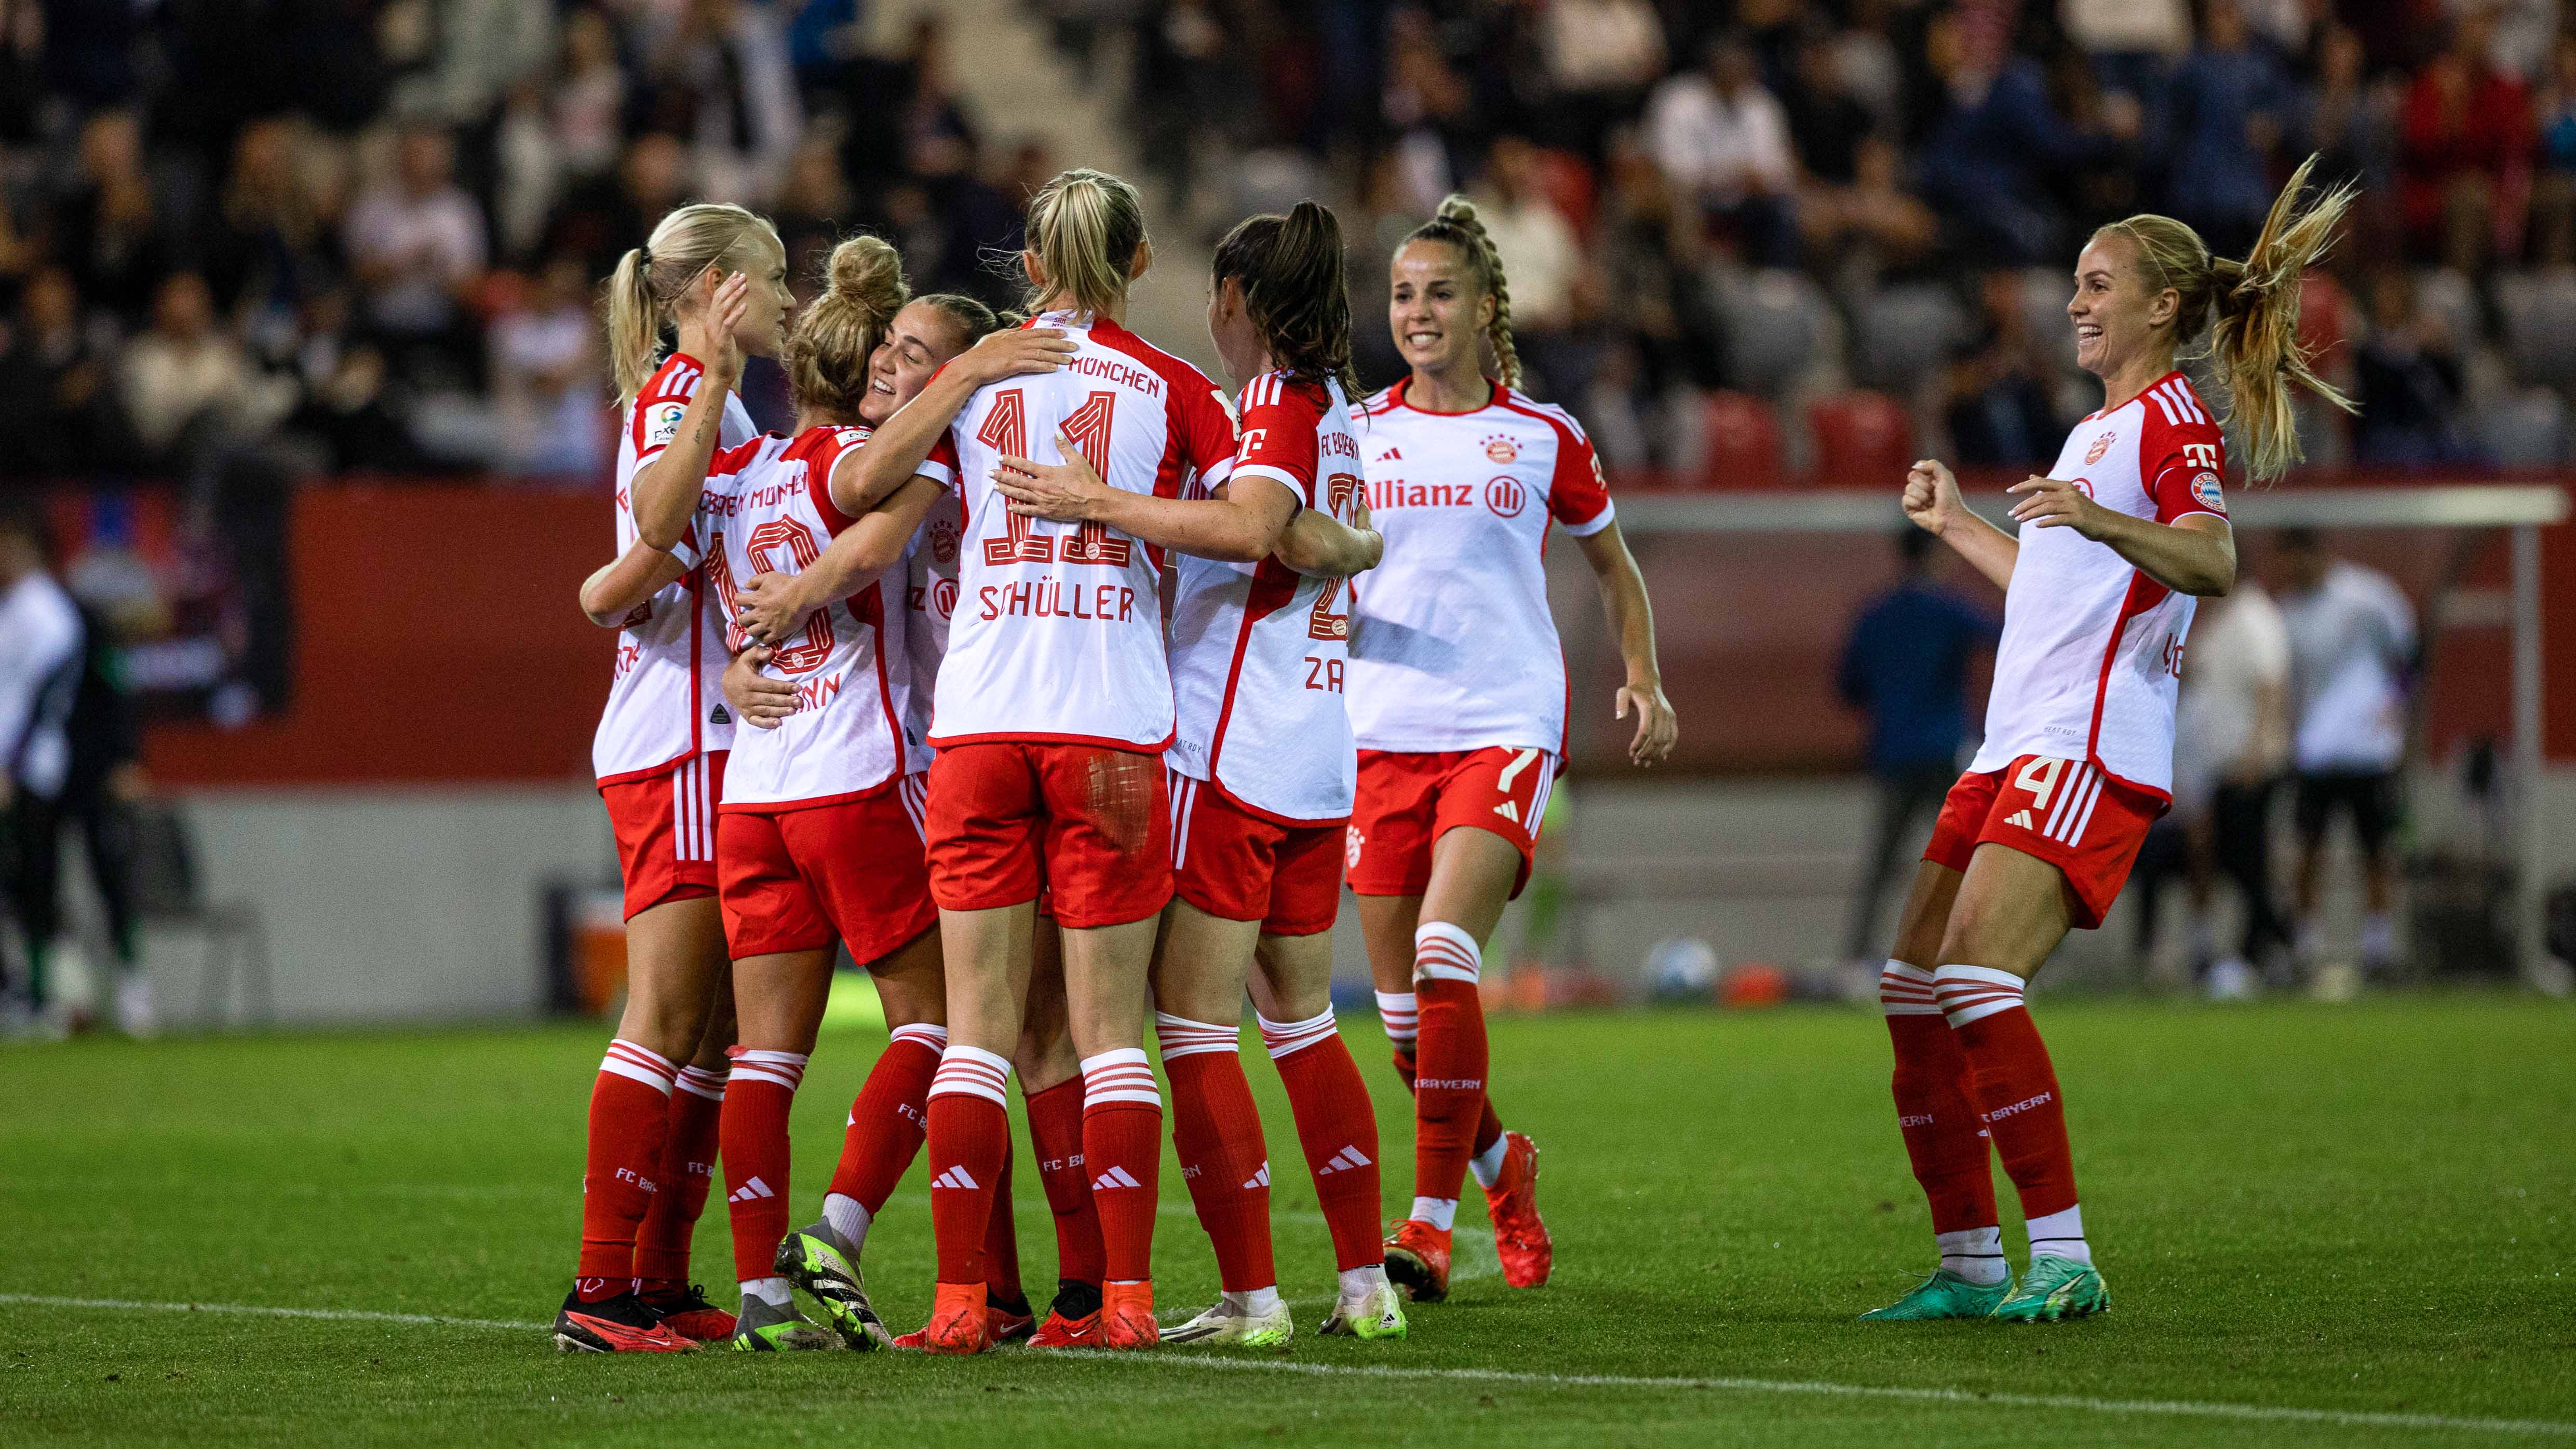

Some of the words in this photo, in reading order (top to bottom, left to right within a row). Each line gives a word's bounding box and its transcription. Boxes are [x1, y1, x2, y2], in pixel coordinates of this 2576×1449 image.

[1069, 357, 1159, 398] MÜNCHEN
[2182, 443, 2218, 470] T
[976, 388, 1131, 568] 11
[979, 574, 1135, 624] SCHÜLLER
[1304, 656, 1344, 695] ZA
[1497, 746, 1539, 794] 7
[2014, 756, 2066, 810] 4
[898, 1103, 918, 1120] FC
[1991, 1091, 2052, 1121] BAYERN
[615, 1167, 636, 1183] FC
[1044, 1159, 1062, 1172] FC
